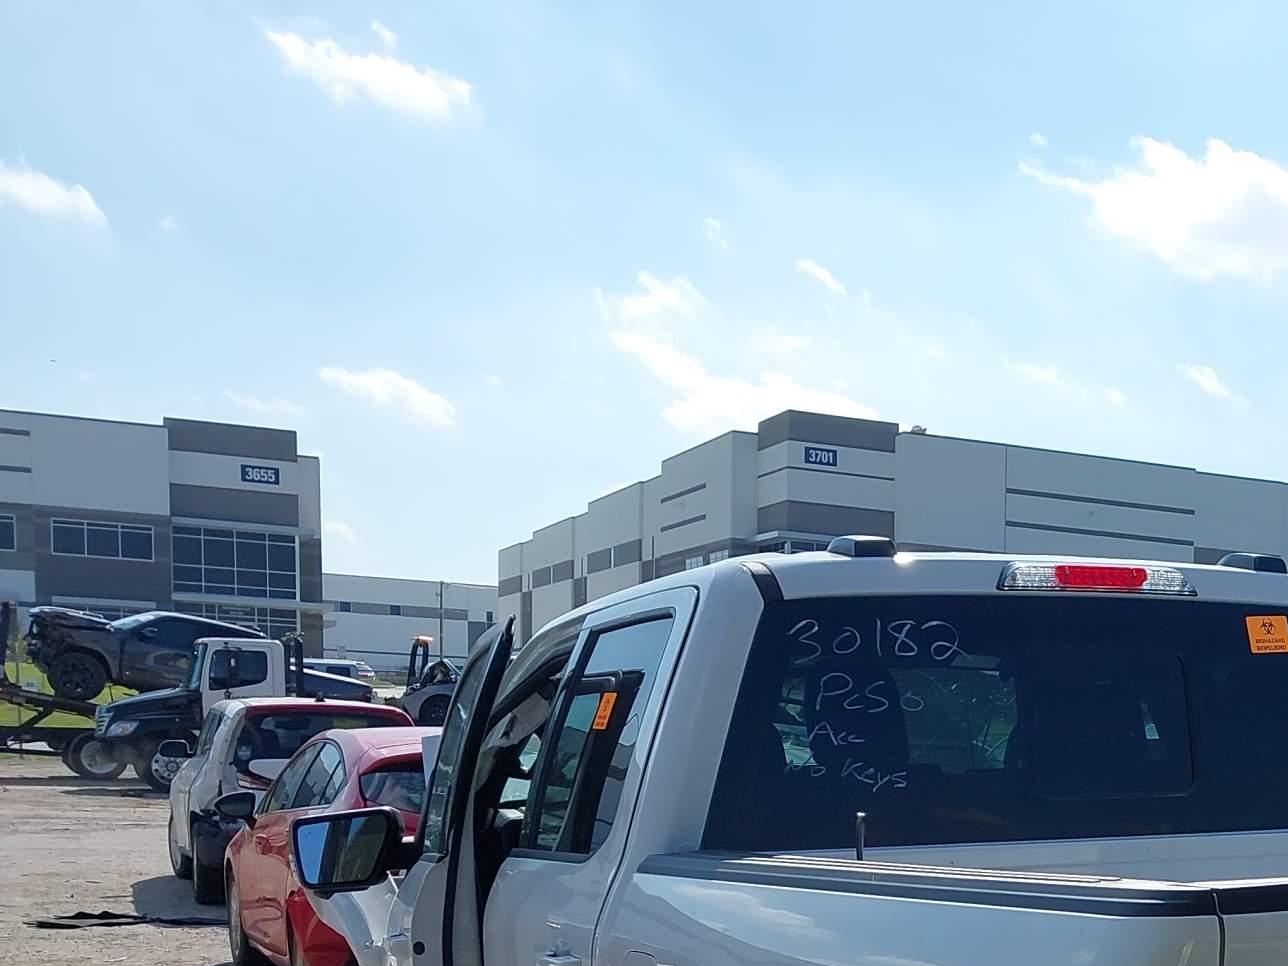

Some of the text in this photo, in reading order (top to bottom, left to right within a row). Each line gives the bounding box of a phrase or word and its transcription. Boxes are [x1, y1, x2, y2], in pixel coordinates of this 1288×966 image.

[808, 449, 834, 464] 3701
[245, 467, 275, 482] 3655
[786, 618, 973, 664] 30182
